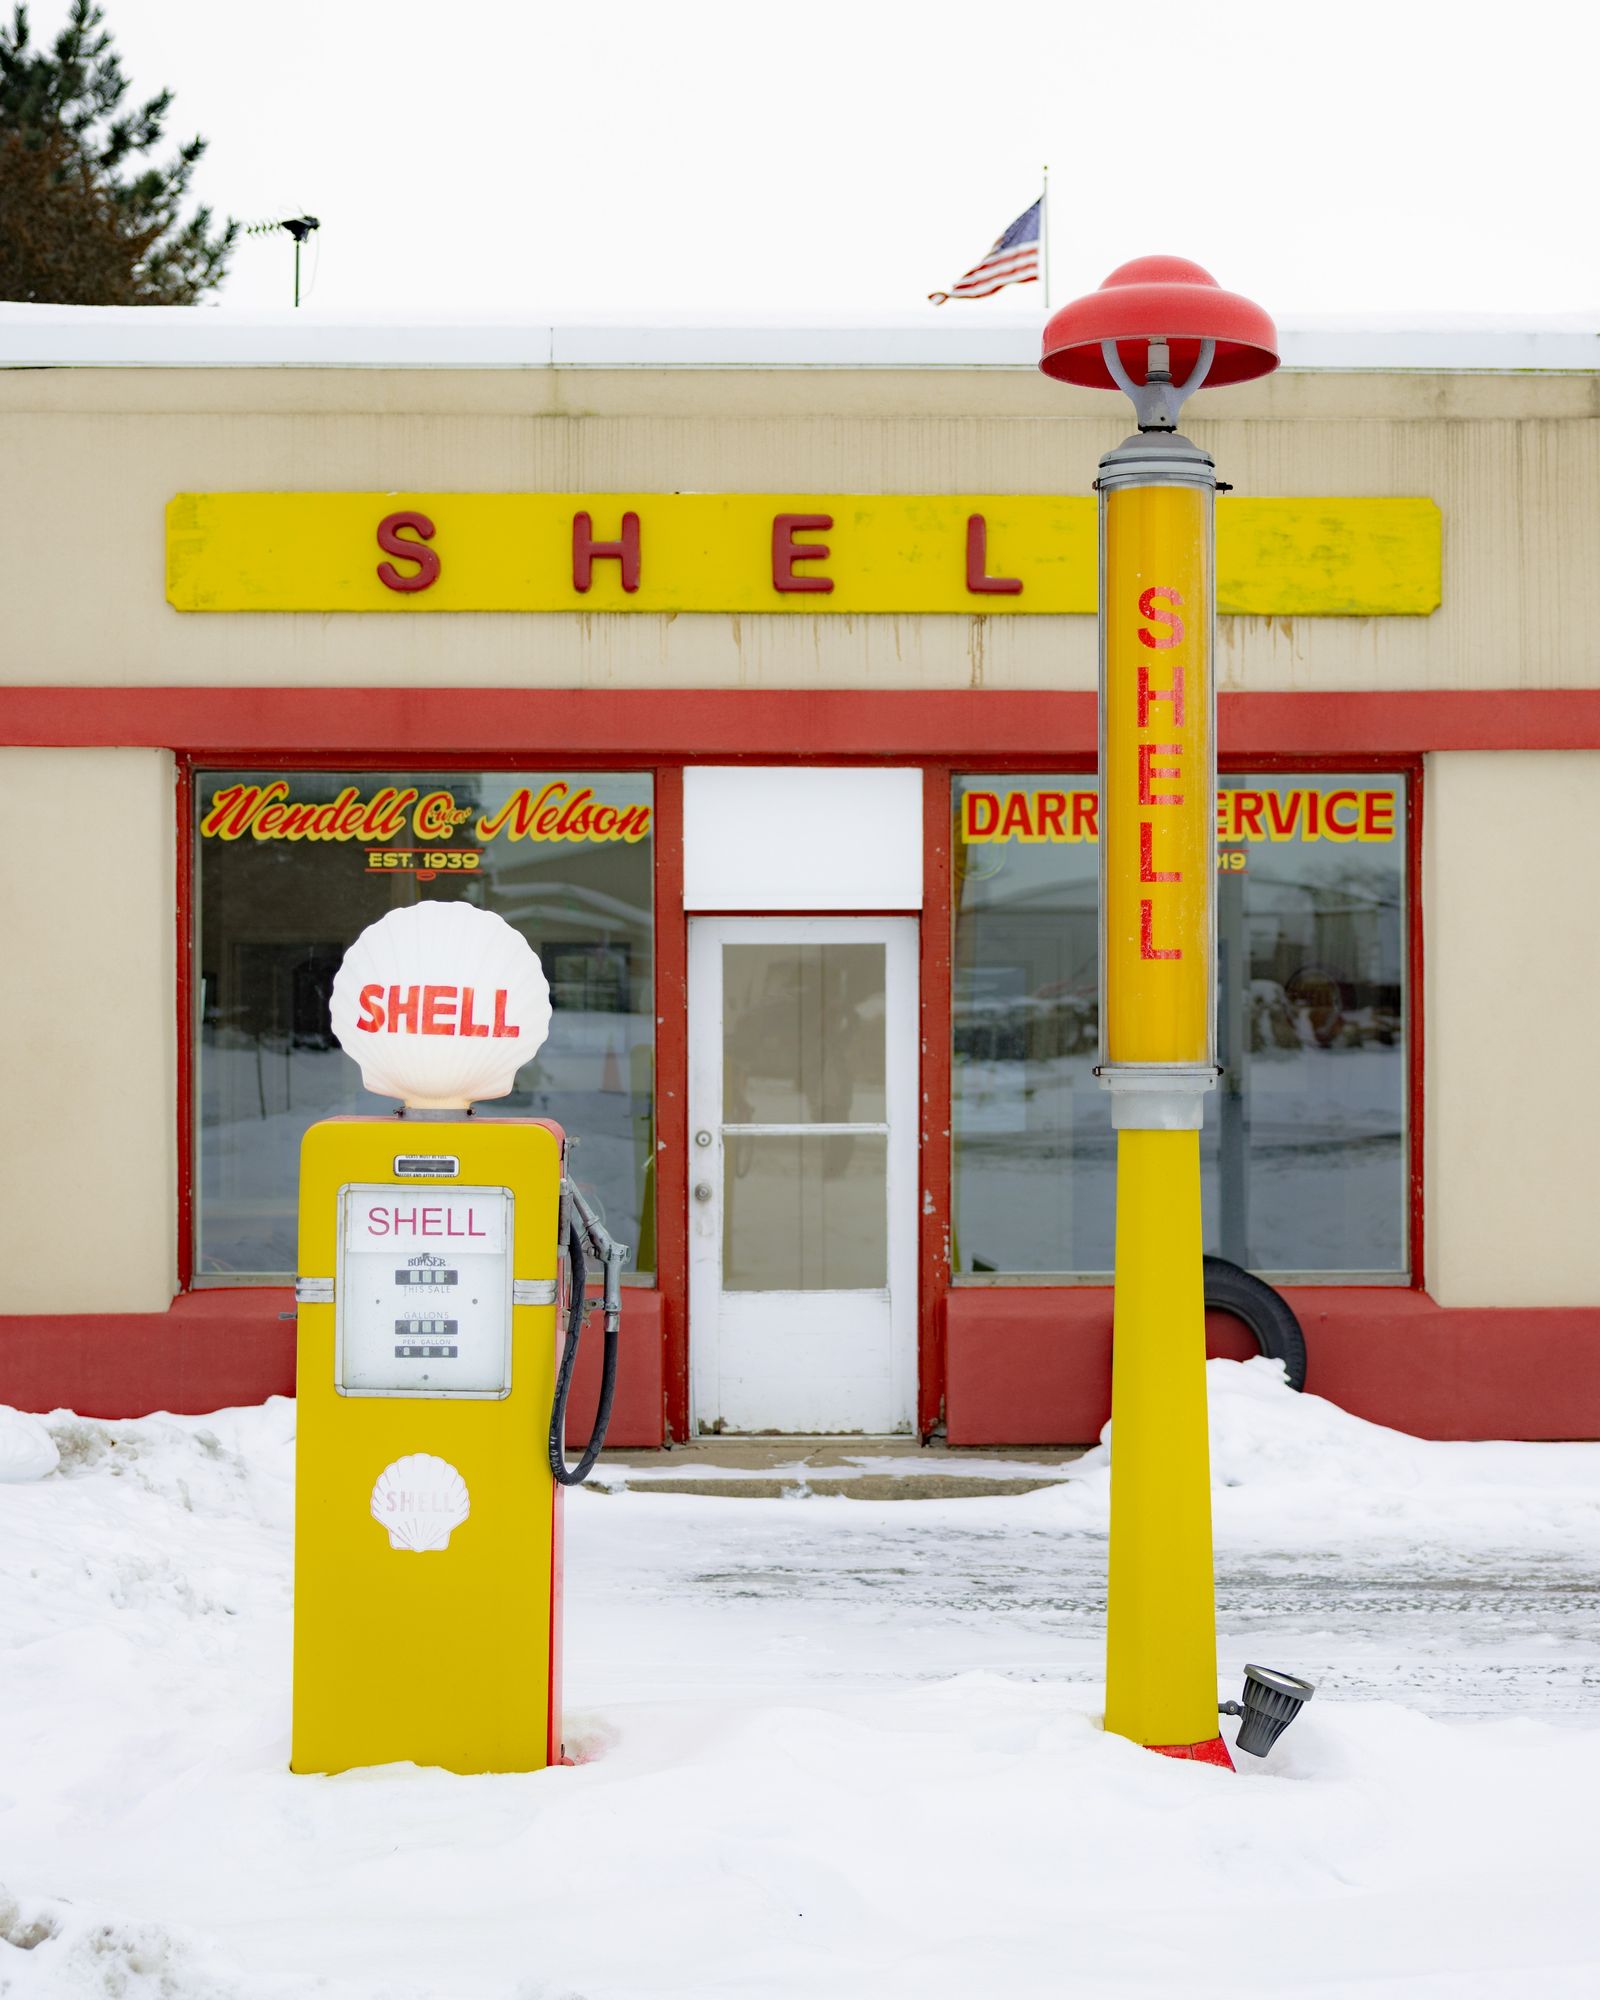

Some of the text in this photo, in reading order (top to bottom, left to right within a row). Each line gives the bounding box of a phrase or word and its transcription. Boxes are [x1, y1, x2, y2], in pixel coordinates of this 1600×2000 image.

[377, 511, 1024, 594] SHEL
[1136, 586, 1185, 961] SHELL
[201, 780, 418, 842] Wendell
[475, 782, 652, 844] Nelson
[961, 788, 1397, 844] DARR RVICE
[369, 852, 480, 869] EST. 1939
[1217, 852, 1247, 870] 19
[357, 984, 520, 1038] SHELL
[367, 1207, 487, 1237] SHELL
[407, 1255, 447, 1268] BOWSER
[403, 1285, 451, 1295] THIS SALE
[403, 1311, 450, 1320] GALLONS
[386, 1490, 456, 1513] SHELL
